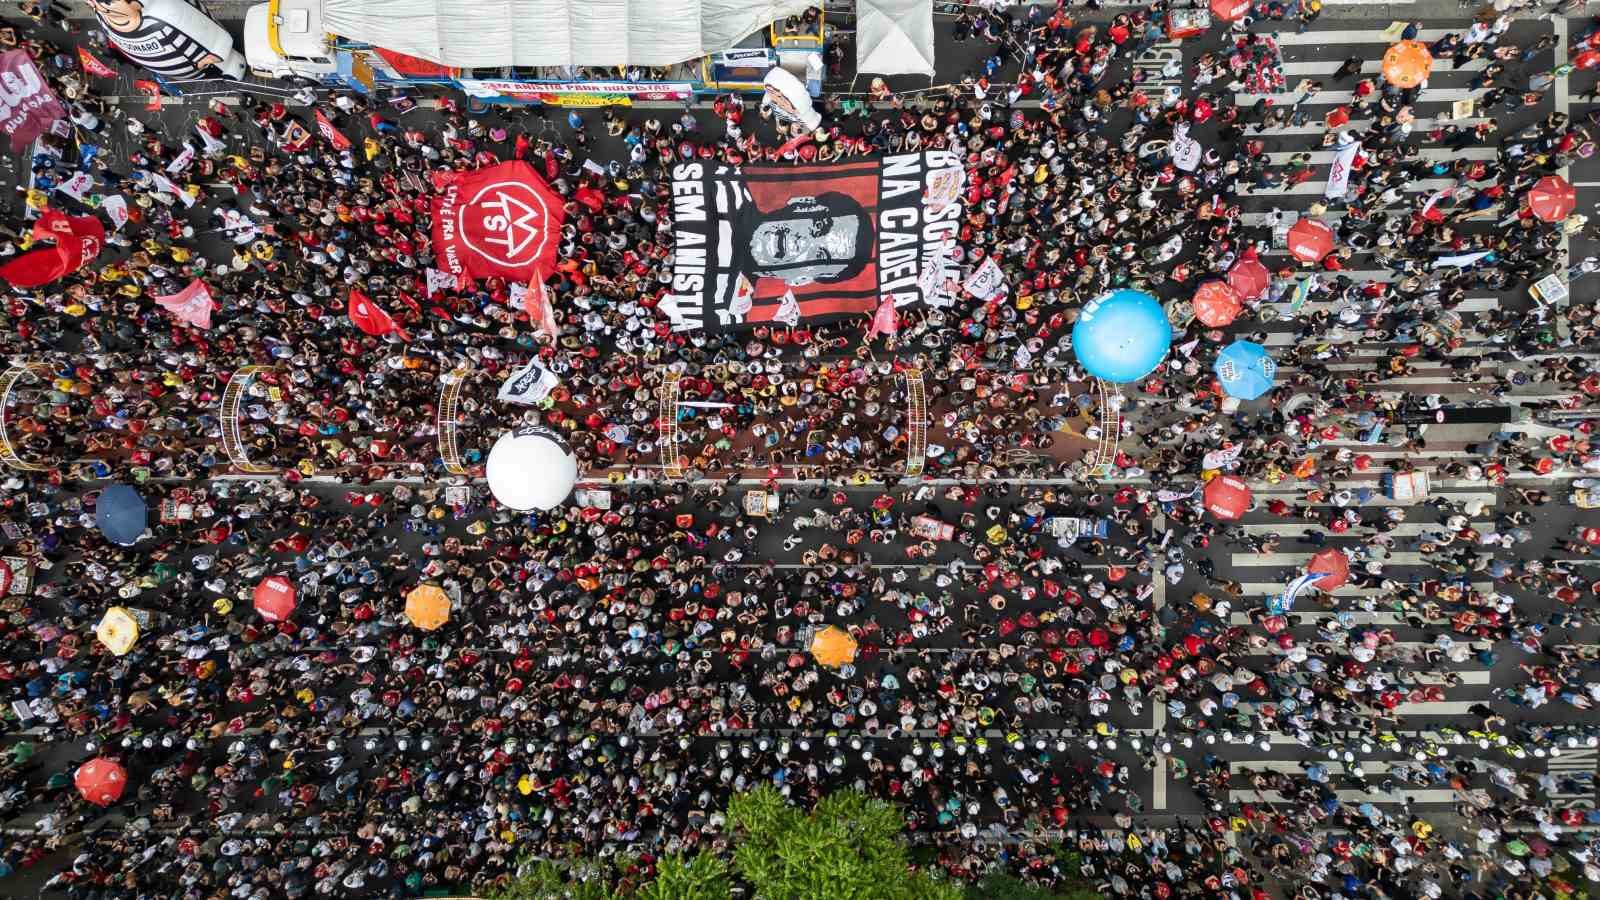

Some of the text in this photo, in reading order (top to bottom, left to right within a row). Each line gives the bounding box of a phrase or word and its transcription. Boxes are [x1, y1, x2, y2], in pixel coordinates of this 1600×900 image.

[671, 163, 706, 332] SEM ANISTIA
[880, 153, 921, 309] NA CADEIA
